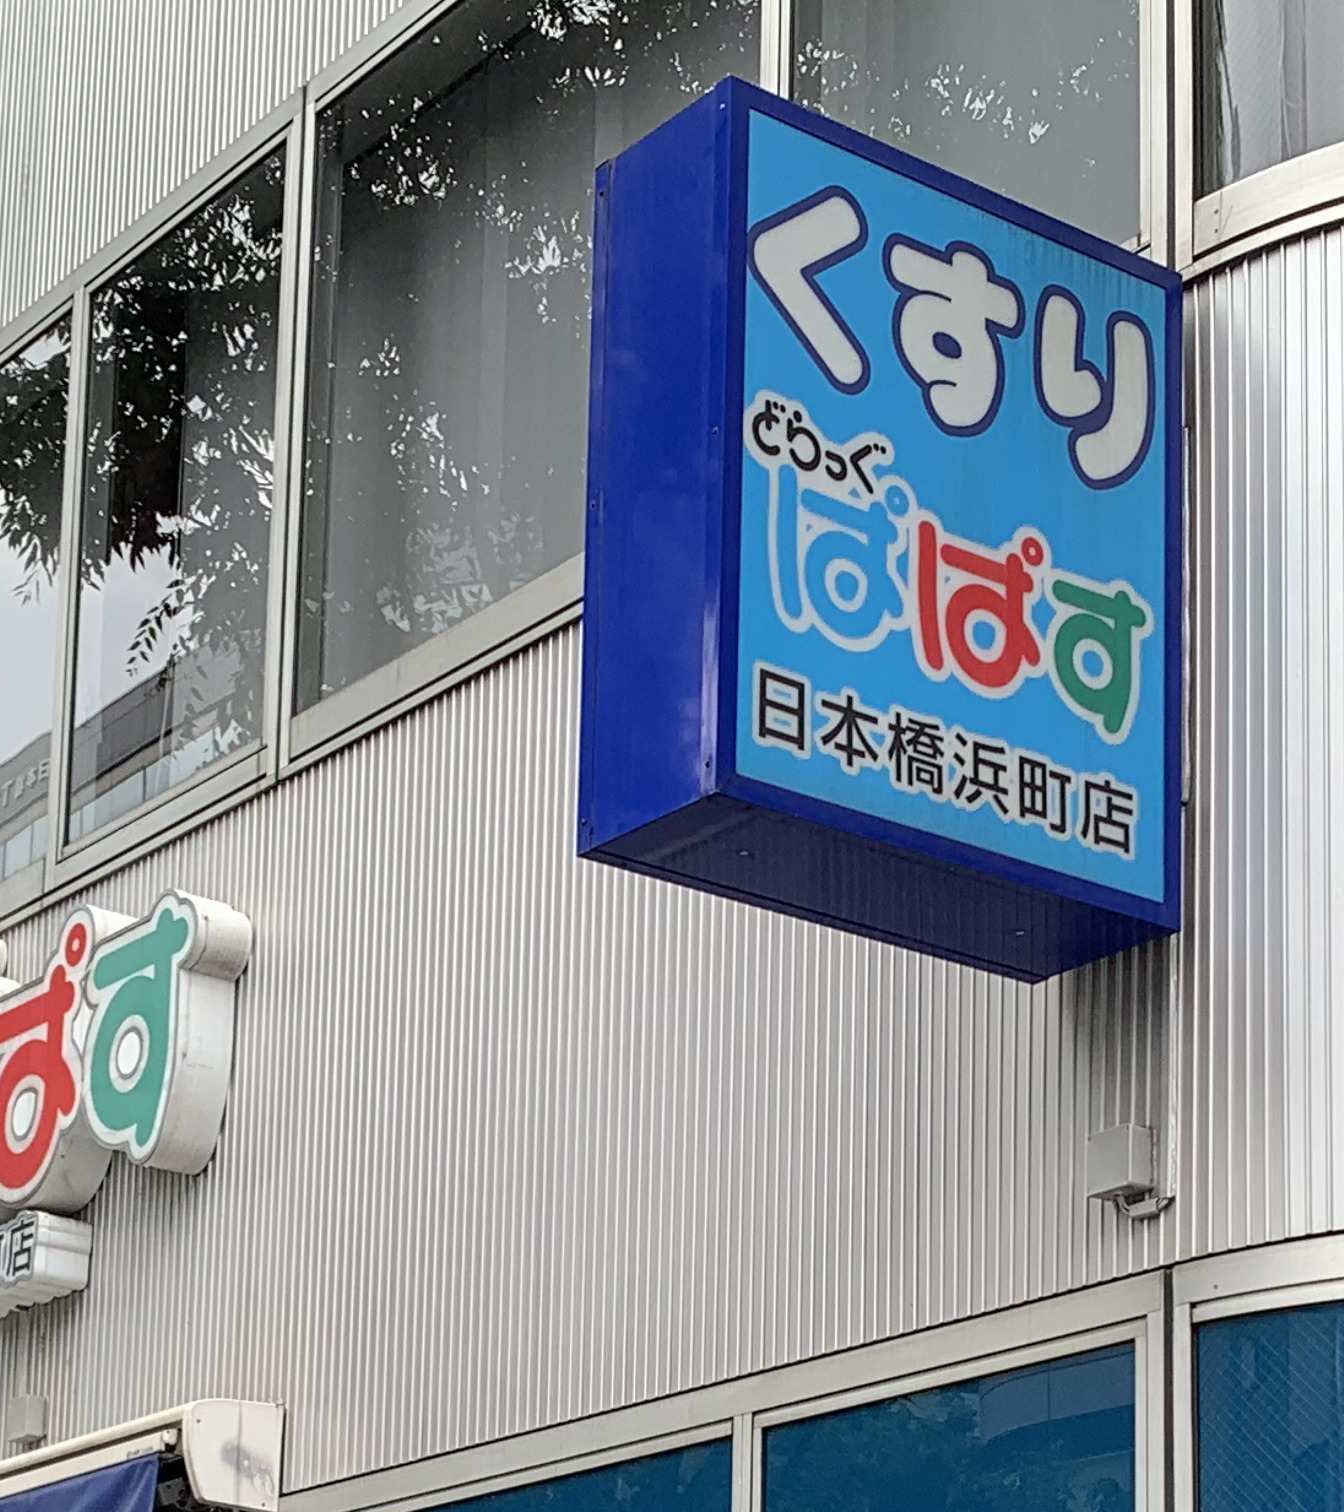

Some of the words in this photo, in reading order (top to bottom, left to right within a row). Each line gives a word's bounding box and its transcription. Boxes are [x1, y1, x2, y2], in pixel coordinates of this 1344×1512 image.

[746, 183, 1158, 490] くすり
[751, 399, 888, 495] どらっぐ
[765, 463, 1150, 735] ぱぱす
[756, 668, 1137, 855] 日本橋浜町店
